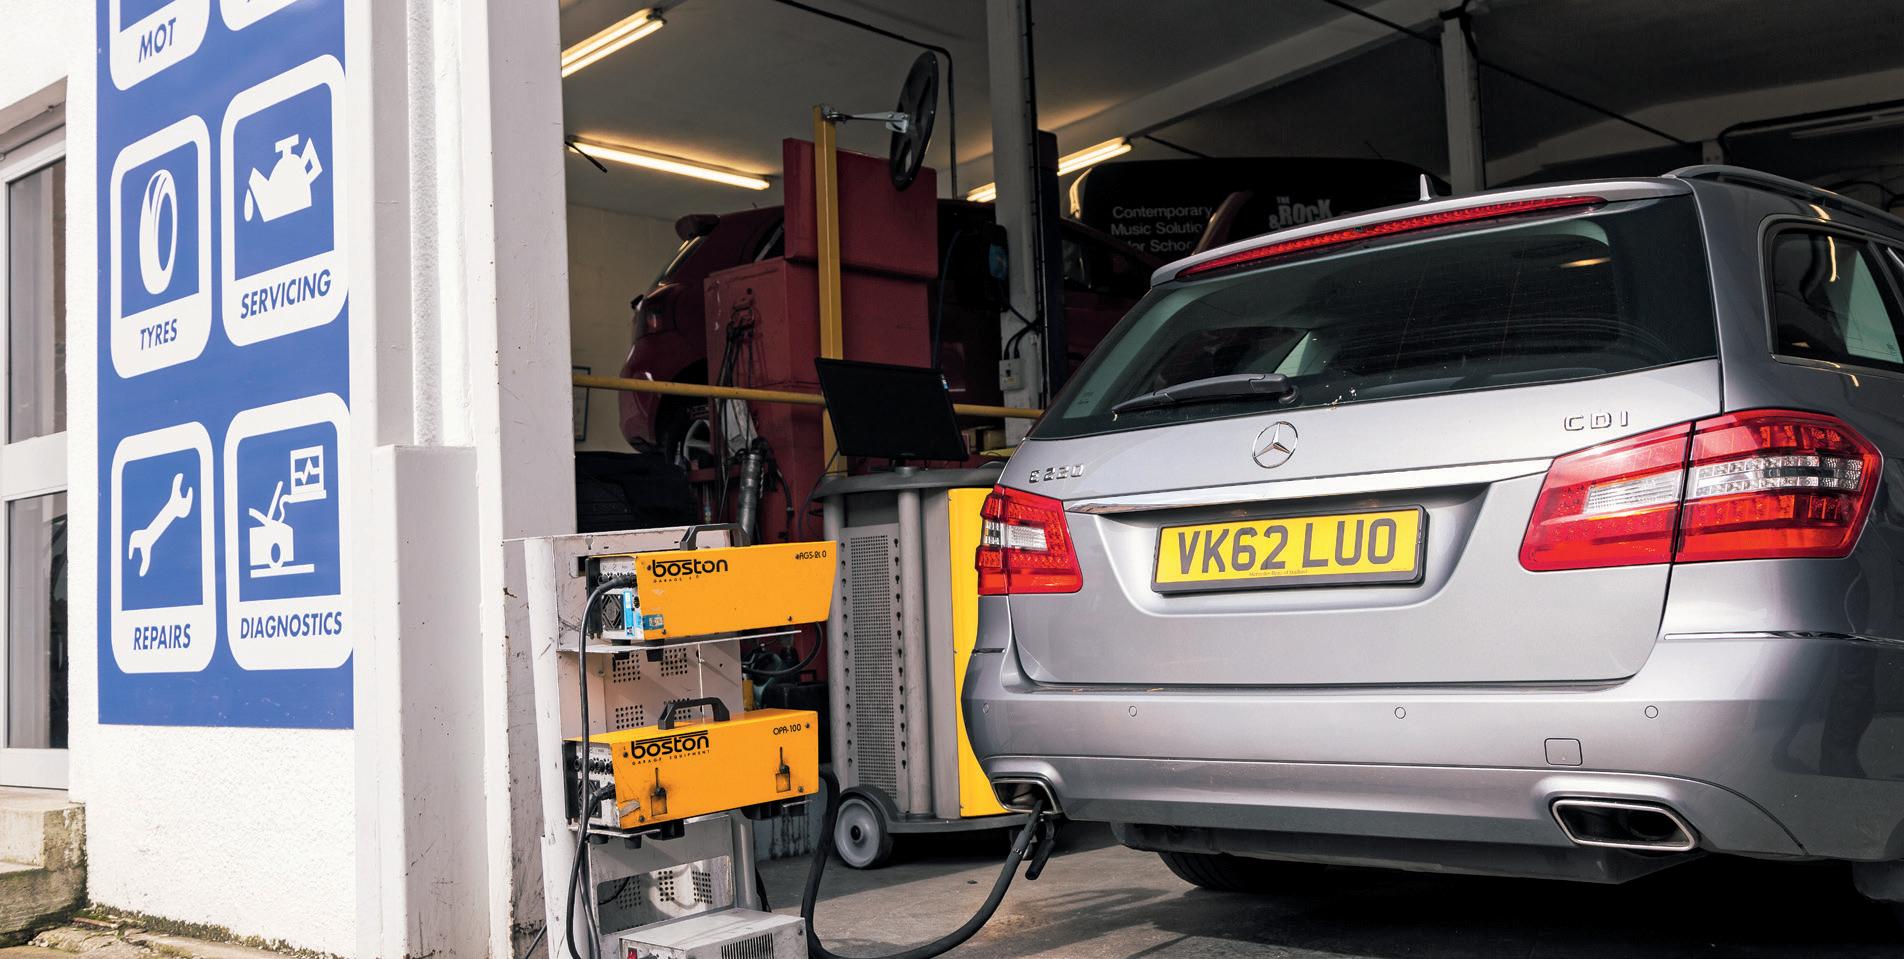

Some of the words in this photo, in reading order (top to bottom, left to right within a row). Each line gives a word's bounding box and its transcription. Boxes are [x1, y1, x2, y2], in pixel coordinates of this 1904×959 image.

[138, 18, 177, 63] MOT
[1112, 205, 1213, 221] Contemporary
[1110, 222, 1152, 236] Music
[1156, 221, 1203, 235] Solutio
[240, 268, 331, 319] SERVICING
[140, 318, 178, 351] TYRES
[1563, 410, 1629, 431] CDI
[1029, 469, 1041, 483] E
[1043, 463, 1085, 482] 220
[1177, 524, 1289, 575] VK62
[1302, 517, 1398, 569] LUO
[652, 558, 729, 578] boston
[133, 623, 192, 651] REPAIRS
[240, 611, 343, 640] DIAGNOSTICS
[772, 723, 802, 736] OPA-100
[630, 733, 710, 760] boston
[631, 757, 662, 766] GARAGE
[669, 749, 711, 760] EQUIPMENT
